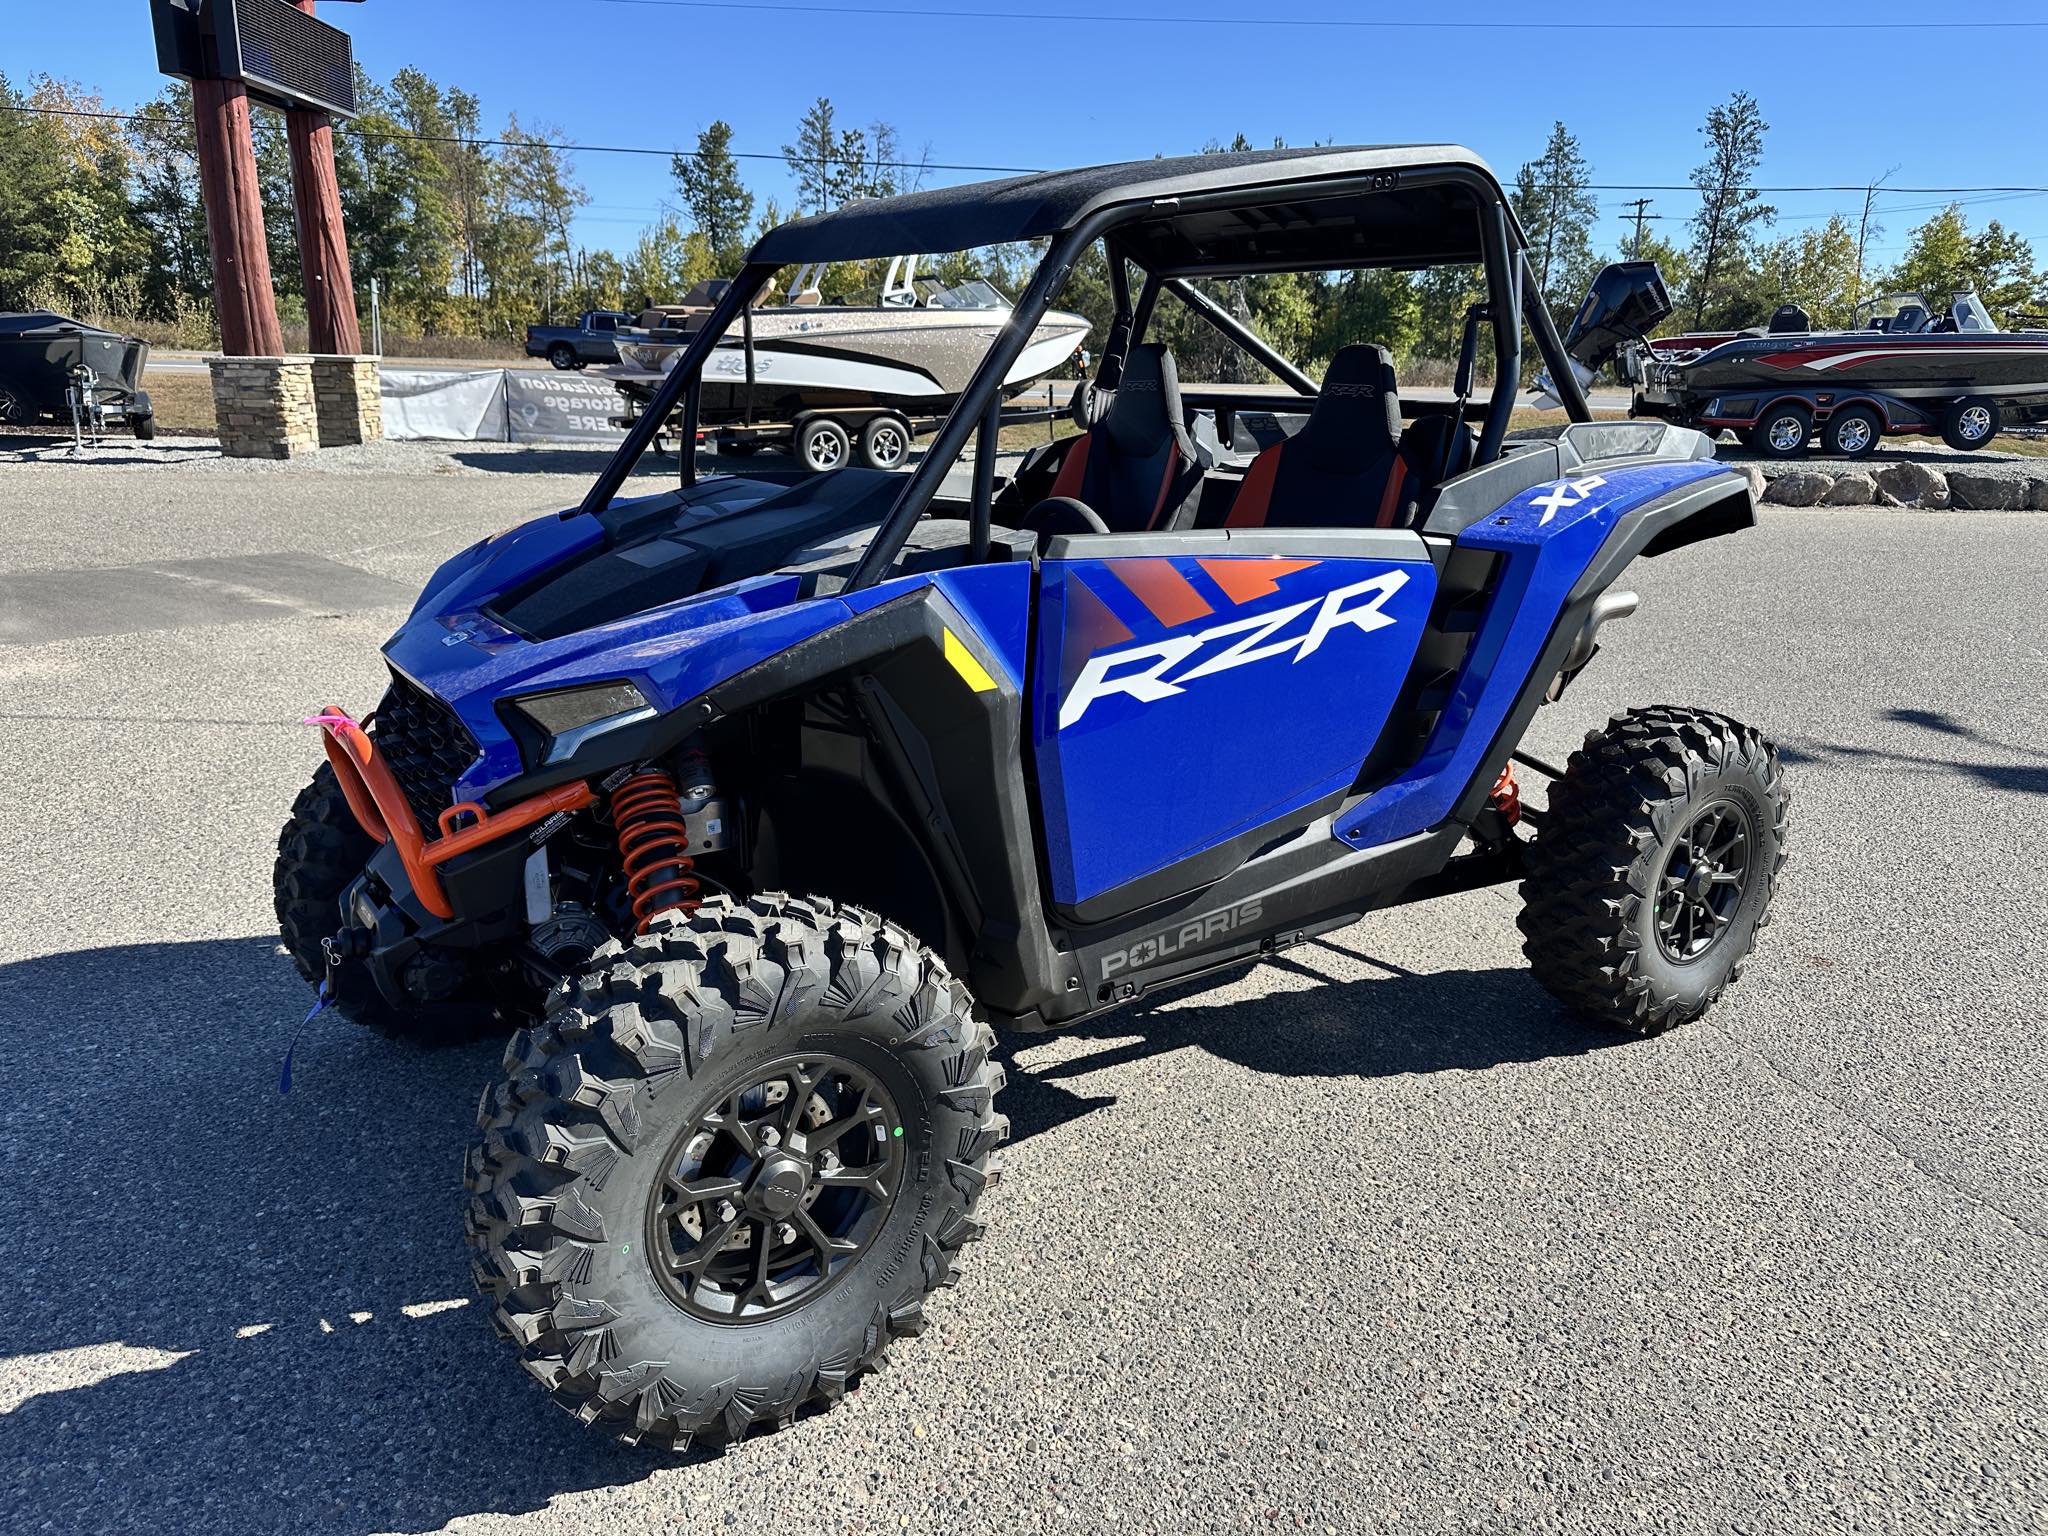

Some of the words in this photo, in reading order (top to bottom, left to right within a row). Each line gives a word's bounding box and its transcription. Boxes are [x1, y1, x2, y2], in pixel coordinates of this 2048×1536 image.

[1645, 281, 1665, 311] MERCURY
[1528, 475, 1608, 528] XP
[1059, 569, 1411, 731] RZR
[530, 810, 566, 840] POLARIS
[1101, 900, 1264, 980] POLARIS
